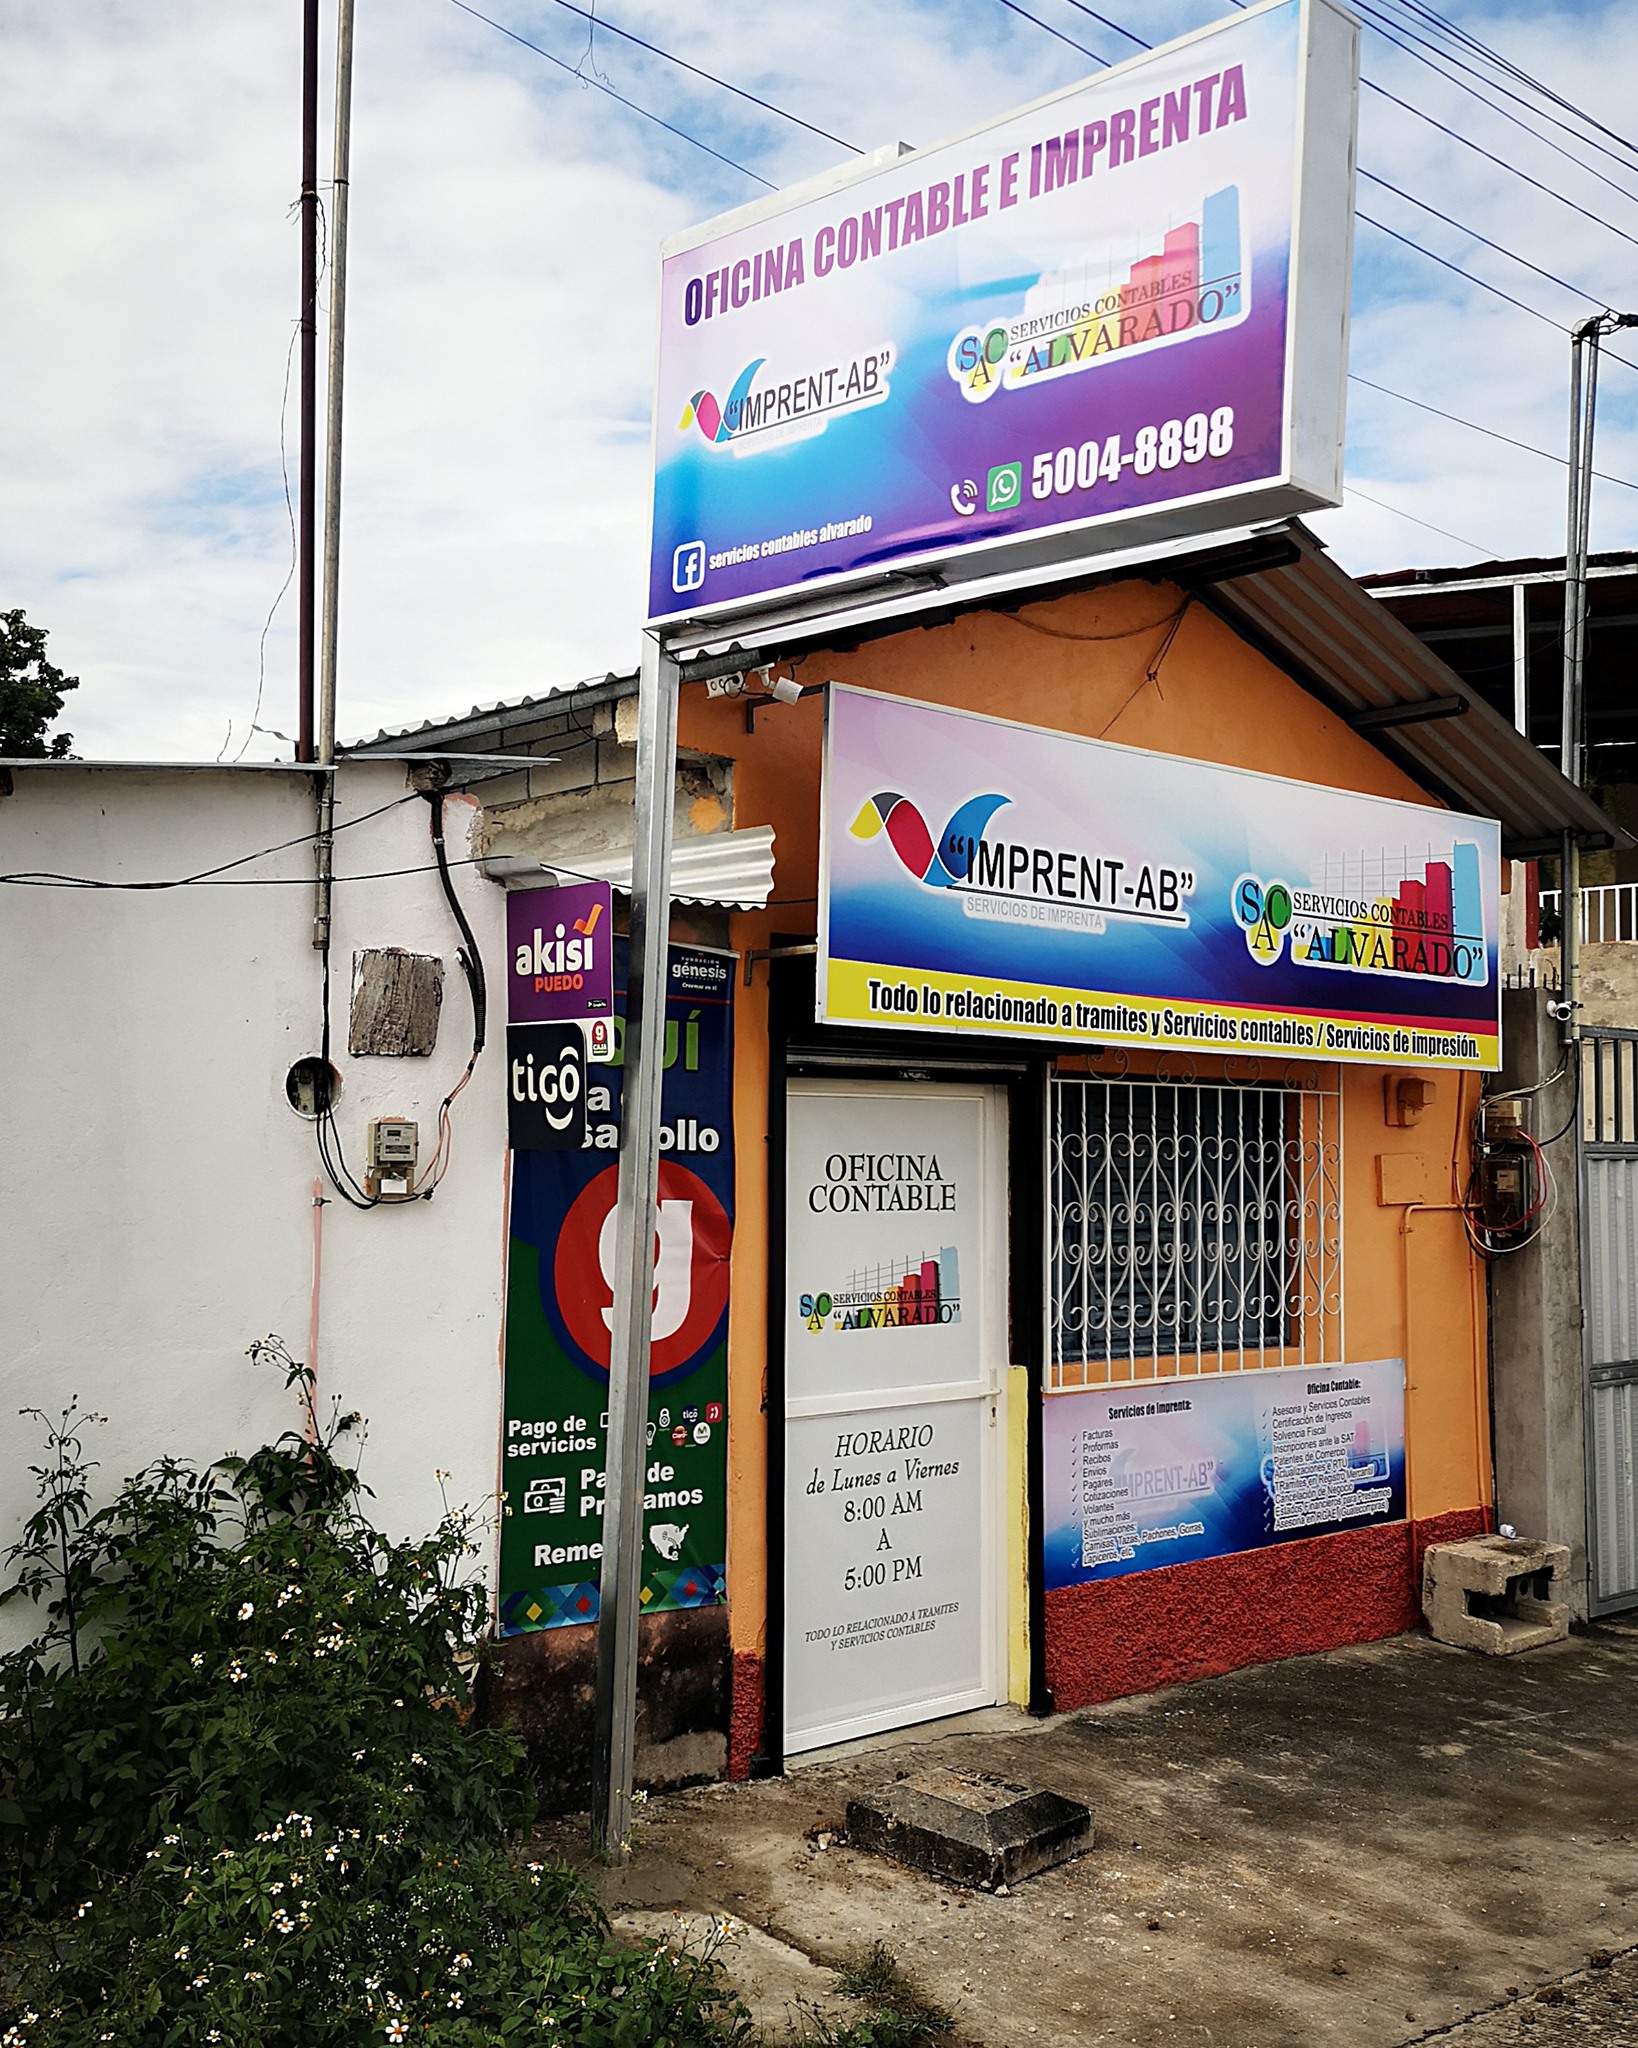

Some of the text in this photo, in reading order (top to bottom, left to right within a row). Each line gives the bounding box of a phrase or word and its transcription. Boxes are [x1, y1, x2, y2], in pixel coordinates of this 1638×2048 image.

[684, 63, 1247, 326] OFICINA CONTABLE E IMPRENTA
[1010, 270, 1192, 341] SERVICIOS CONTABLES
[1031, 405, 1234, 500] 5004-8898
[709, 515, 872, 570] servicios contables alvarado
[967, 896, 1102, 929] SERVICIOS DE IMPRENTA
[1293, 892, 1448, 930] SERVICIOS CONTABLES
[672, 962, 727, 979] génesis
[534, 974, 584, 992] PUEDO
[868, 981, 918, 1013] Todo
[923, 986, 941, 1016] lo
[945, 990, 1058, 1026] relacionado
[1062, 1004, 1072, 1027] a
[1076, 1003, 1147, 1034] tramites
[1151, 1013, 1160, 1037] y
[1164, 1009, 1237, 1040] Servicios
[1241, 1017, 1313, 1047] contables
[1326, 1024, 1390, 1052] Servicios
[1393, 1029, 1409, 1053] de
[1412, 1032, 1479, 1058] impresión.
[826, 1153, 944, 1182] OFICINA
[809, 1183, 956, 1213] CONTABLE
[833, 1289, 936, 1304] SERVICIOS CONTABLES
[1307, 1383, 1330, 1395] Oficina
[1108, 1405, 1145, 1420] Servicios
[1146, 1403, 1155, 1415] de
[1308, 1400, 1338, 1412] Servicios
[1339, 1395, 1371, 1407] Contables
[508, 1415, 587, 1439] Pago de
[1315, 1413, 1324, 1423] de
[1325, 1410, 1352, 1423] Ingresos
[835, 1424, 933, 1458] HORARIO
[1082, 1429, 1113, 1441] Facturas
[1272, 1425, 1327, 1441] Solvencia Fiscal
[1273, 1440, 1317, 1454] Inscripciones
[1318, 1438, 1333, 1447] ante
[1341, 1432, 1355, 1443] SAT
[507, 1436, 597, 1457] servicios
[1082, 1440, 1119, 1453] Proformas
[1315, 1448, 1346, 1460] Comercio
[1082, 1454, 1111, 1465] Recibos
[647, 1462, 675, 1482] de
[806, 1458, 959, 1495] de Lunes a Viernes
[844, 1489, 923, 1522] 8:00 AM
[1083, 1488, 1128, 1502] Cotizaciones
[1083, 1502, 1114, 1515] Volantes
[1083, 1519, 1089, 1528] y
[1089, 1514, 1114, 1526] mucho
[876, 1528, 892, 1551] A
[844, 1555, 923, 1591] 5:00 PM
[805, 1602, 959, 1642] TODO LO RELACIONADO A TRAMITES
[830, 1620, 936, 1650] Y SERVICIOS CONTABLES
